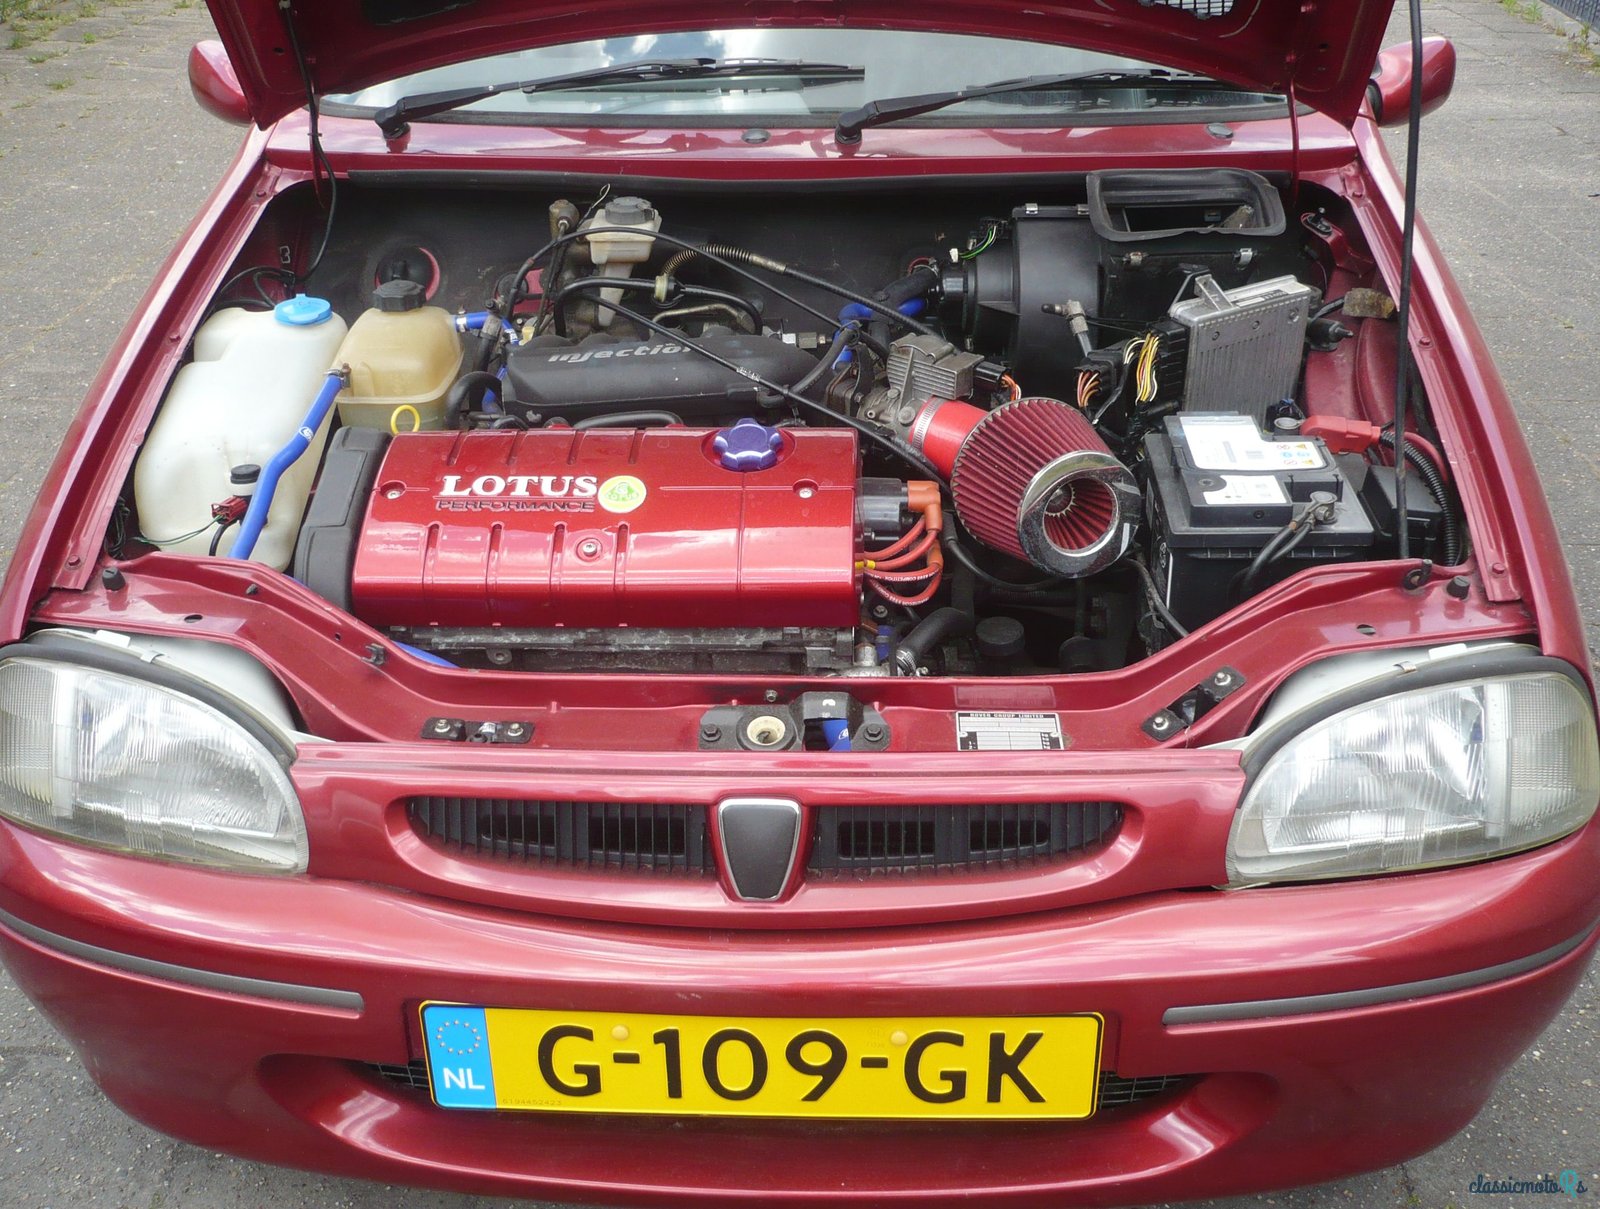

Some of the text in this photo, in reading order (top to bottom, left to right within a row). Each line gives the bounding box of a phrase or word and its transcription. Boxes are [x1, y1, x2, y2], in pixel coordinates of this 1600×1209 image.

[439, 475, 597, 497] LOTUS
[435, 500, 595, 512] PERFORMANCE
[536, 1024, 1045, 1103] G-109-GK
[443, 1067, 485, 1089] NL
